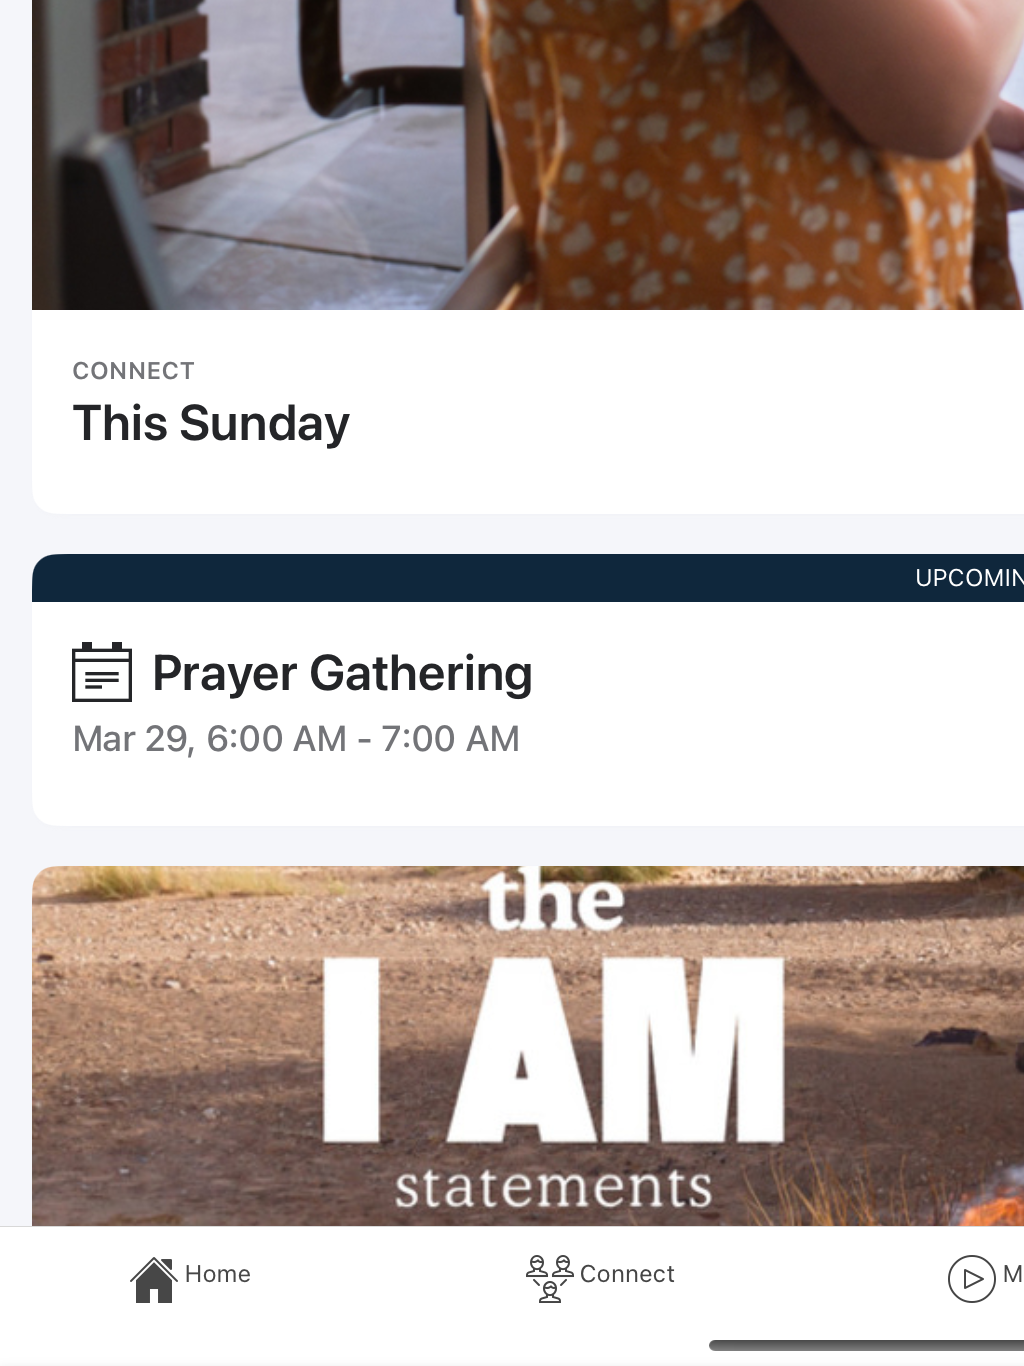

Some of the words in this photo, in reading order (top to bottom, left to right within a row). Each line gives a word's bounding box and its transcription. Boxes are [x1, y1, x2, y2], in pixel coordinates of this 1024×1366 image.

[72, 361, 195, 380] CONNECT
[72, 402, 168, 442] This
[180, 403, 351, 450] Sunday
[154, 653, 298, 700] Prayer
[310, 652, 532, 700] Gathering
[74, 725, 136, 752] Mar
[145, 724, 194, 759] 29,
[207, 724, 283, 753] 6:00
[292, 724, 346, 752] AM
[382, 724, 455, 753] 7:00
[465, 724, 519, 752] AM
[481, 866, 625, 932] the
[323, 956, 380, 1143] I
[446, 956, 786, 1143] AM
[394, 1169, 713, 1208] statements
[185, 1264, 251, 1283] Home
[580, 1264, 675, 1284] Connect
